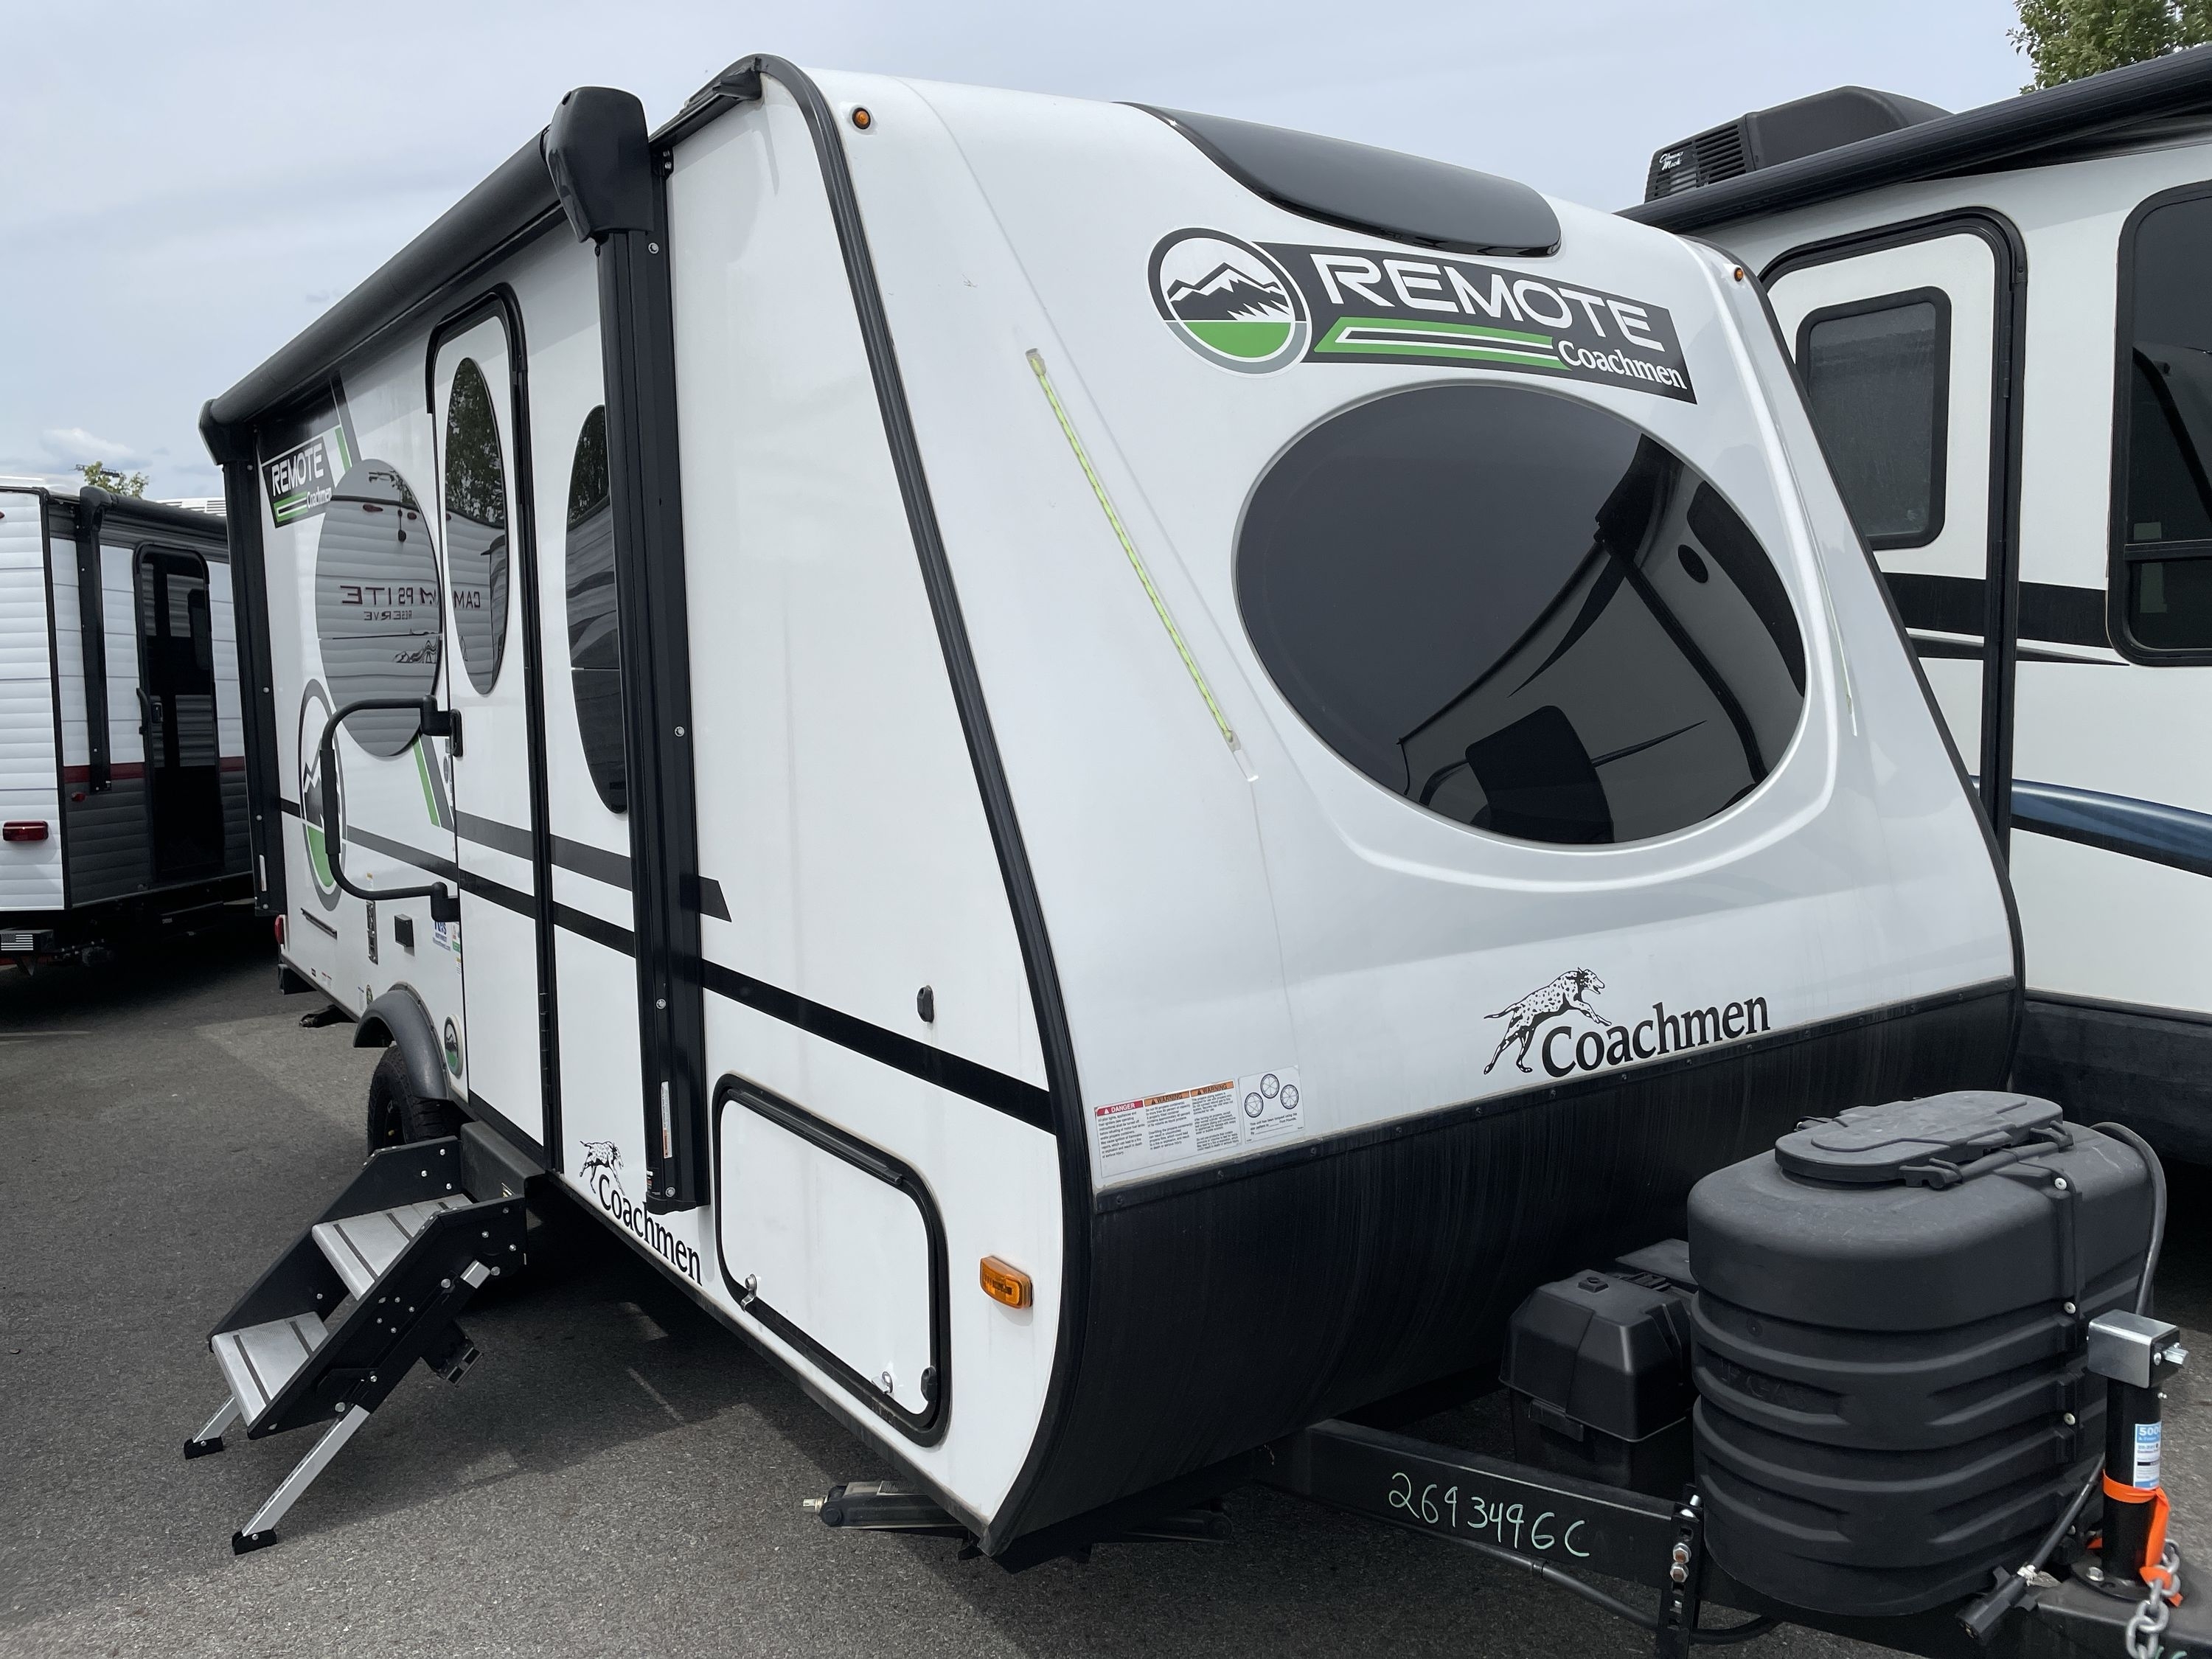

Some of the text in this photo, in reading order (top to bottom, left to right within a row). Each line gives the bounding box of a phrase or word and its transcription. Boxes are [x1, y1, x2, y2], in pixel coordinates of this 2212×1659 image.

[1310, 253, 1666, 352] REMOTE
[1557, 340, 1688, 390] Coachmen
[271, 442, 324, 497] REMOTE
[307, 486, 333, 509] Coachmen
[1541, 995, 1771, 1078] Coachmen
[1110, 1102, 1136, 1113] DANGER
[1156, 1092, 1183, 1105] WARNING
[1202, 1083, 1228, 1094] WARNING
[598, 1173, 703, 1287] Coachmen
